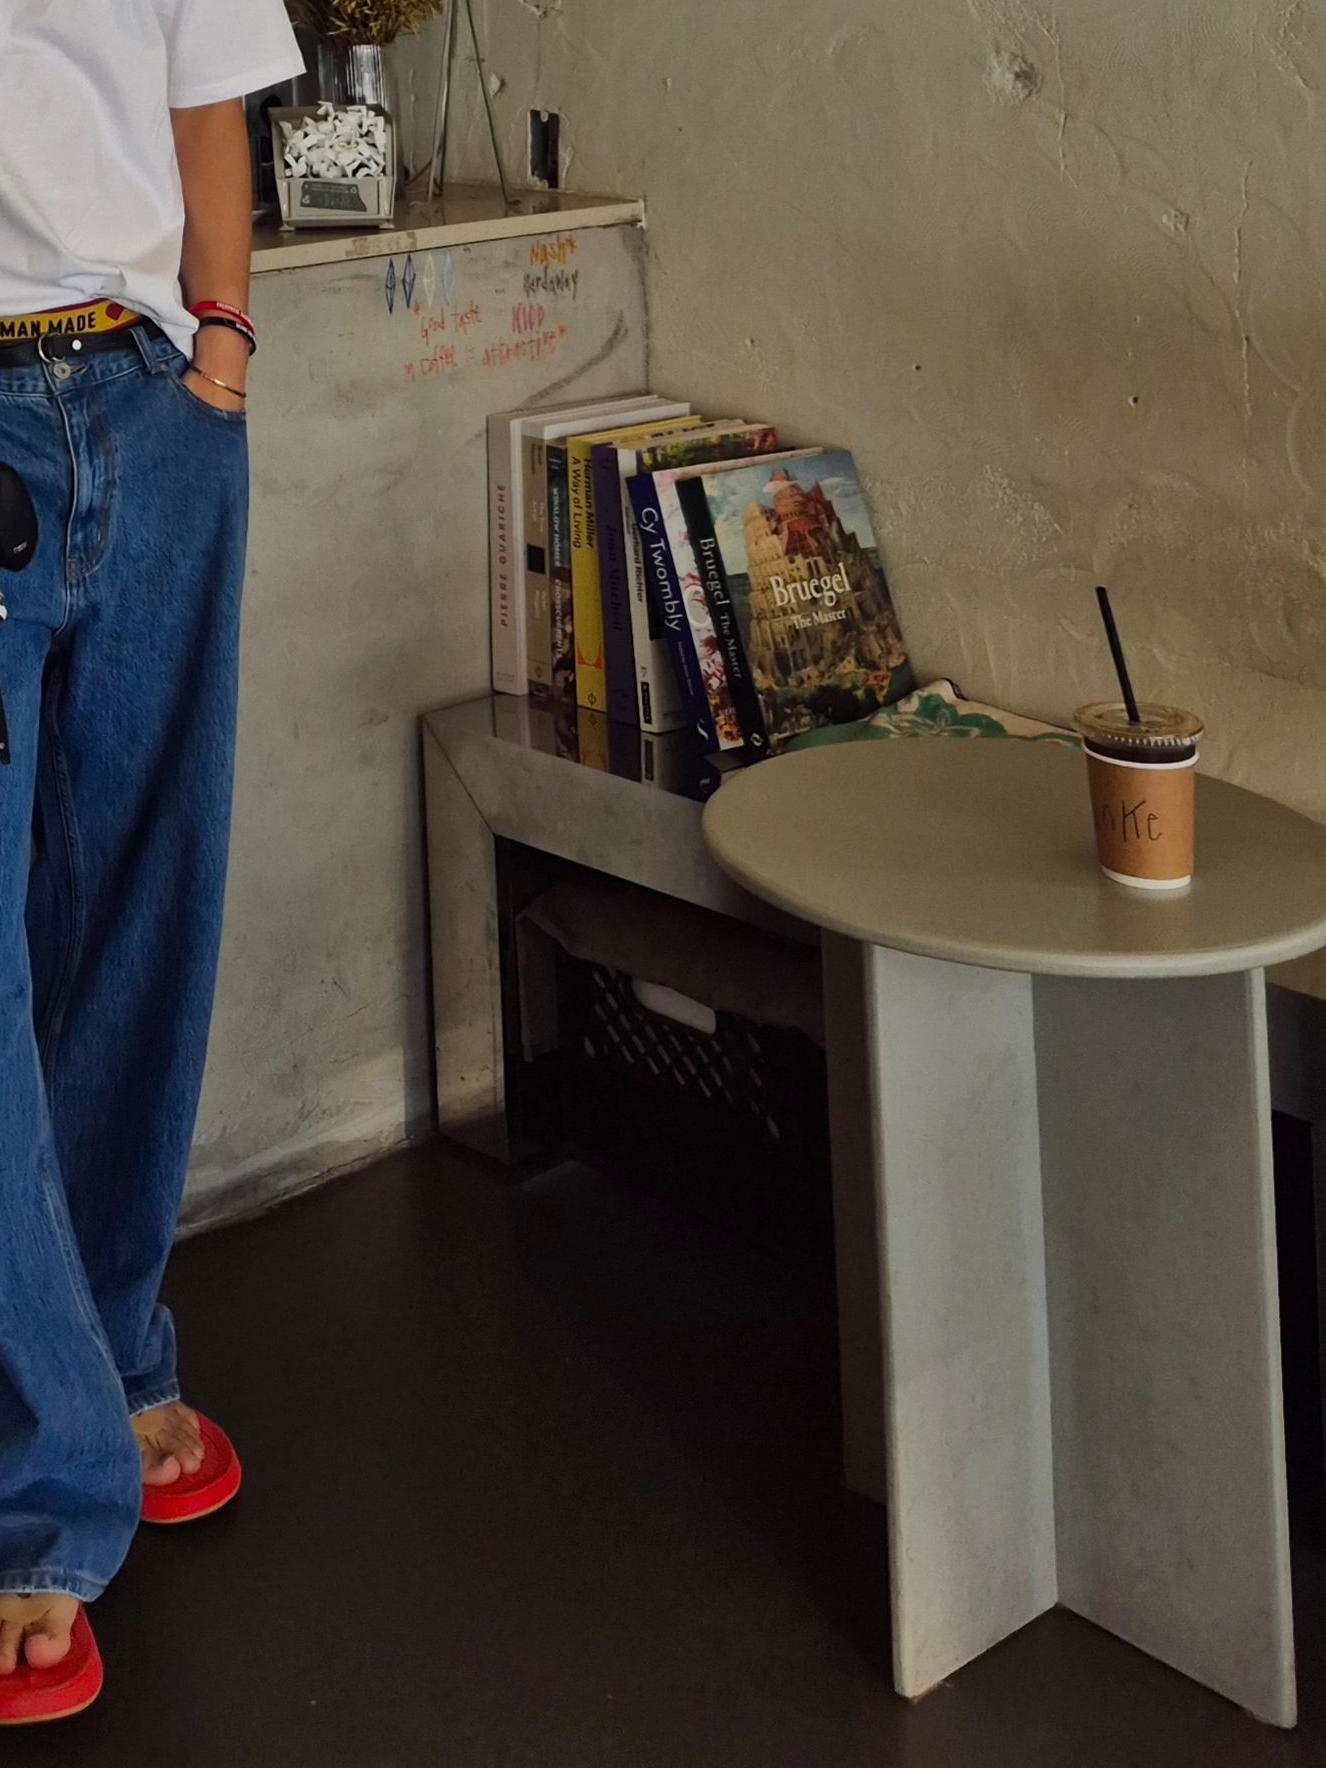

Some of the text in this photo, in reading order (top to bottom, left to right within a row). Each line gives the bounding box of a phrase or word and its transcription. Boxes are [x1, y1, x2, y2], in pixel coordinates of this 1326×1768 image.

[47, 311, 97, 335] MADE
[552, 487, 562, 568] WINSLOW HOMER
[570, 456, 583, 549] A Way of Living
[583, 458, 595, 549] Herman Miller
[496, 483, 510, 629] PIERRE GUARICHE
[634, 566, 644, 603] Richter
[640, 507, 684, 631] Cy Twombly
[768, 561, 852, 607] Bruegel
[699, 537, 742, 679] Bruegel The Master
[793, 610, 847, 630] The Master
